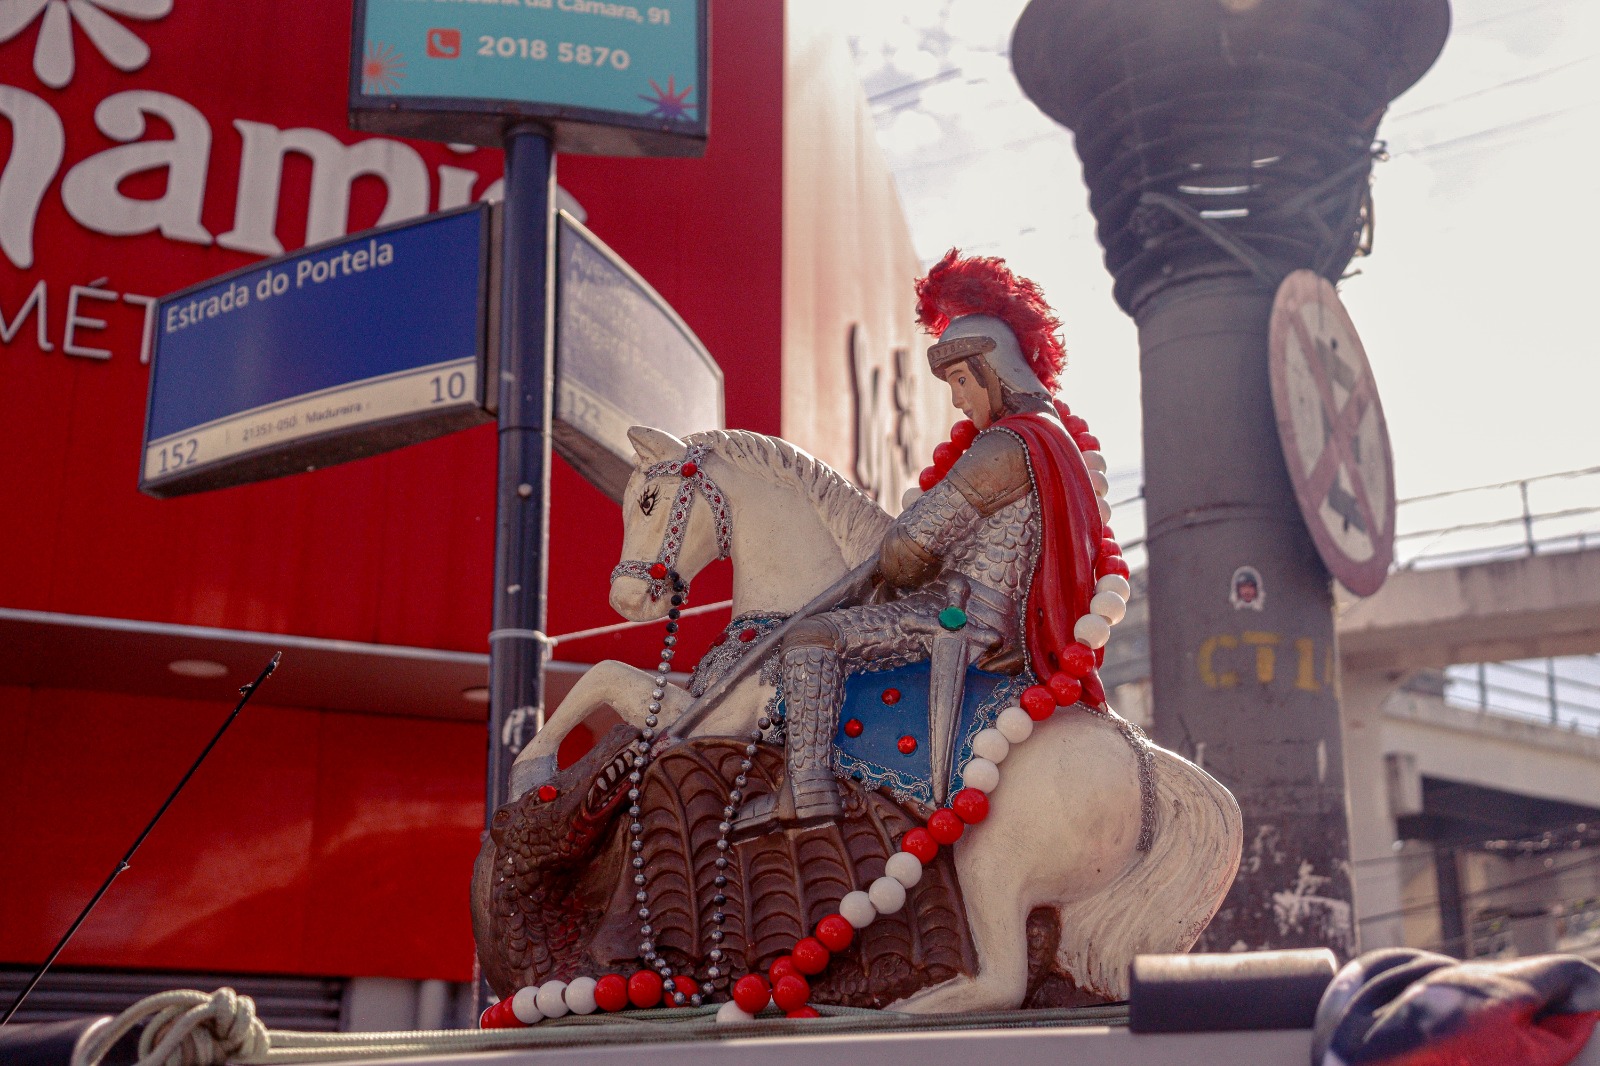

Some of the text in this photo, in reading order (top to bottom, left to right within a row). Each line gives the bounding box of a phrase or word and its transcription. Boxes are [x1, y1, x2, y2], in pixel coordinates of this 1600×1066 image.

[647, 6, 671, 25] 91
[477, 35, 631, 71] 2018 5870
[165, 239, 394, 333] Estrada do Portela
[429, 371, 466, 403] 10
[156, 438, 199, 474] 152
[1198, 630, 1333, 693] CT1
